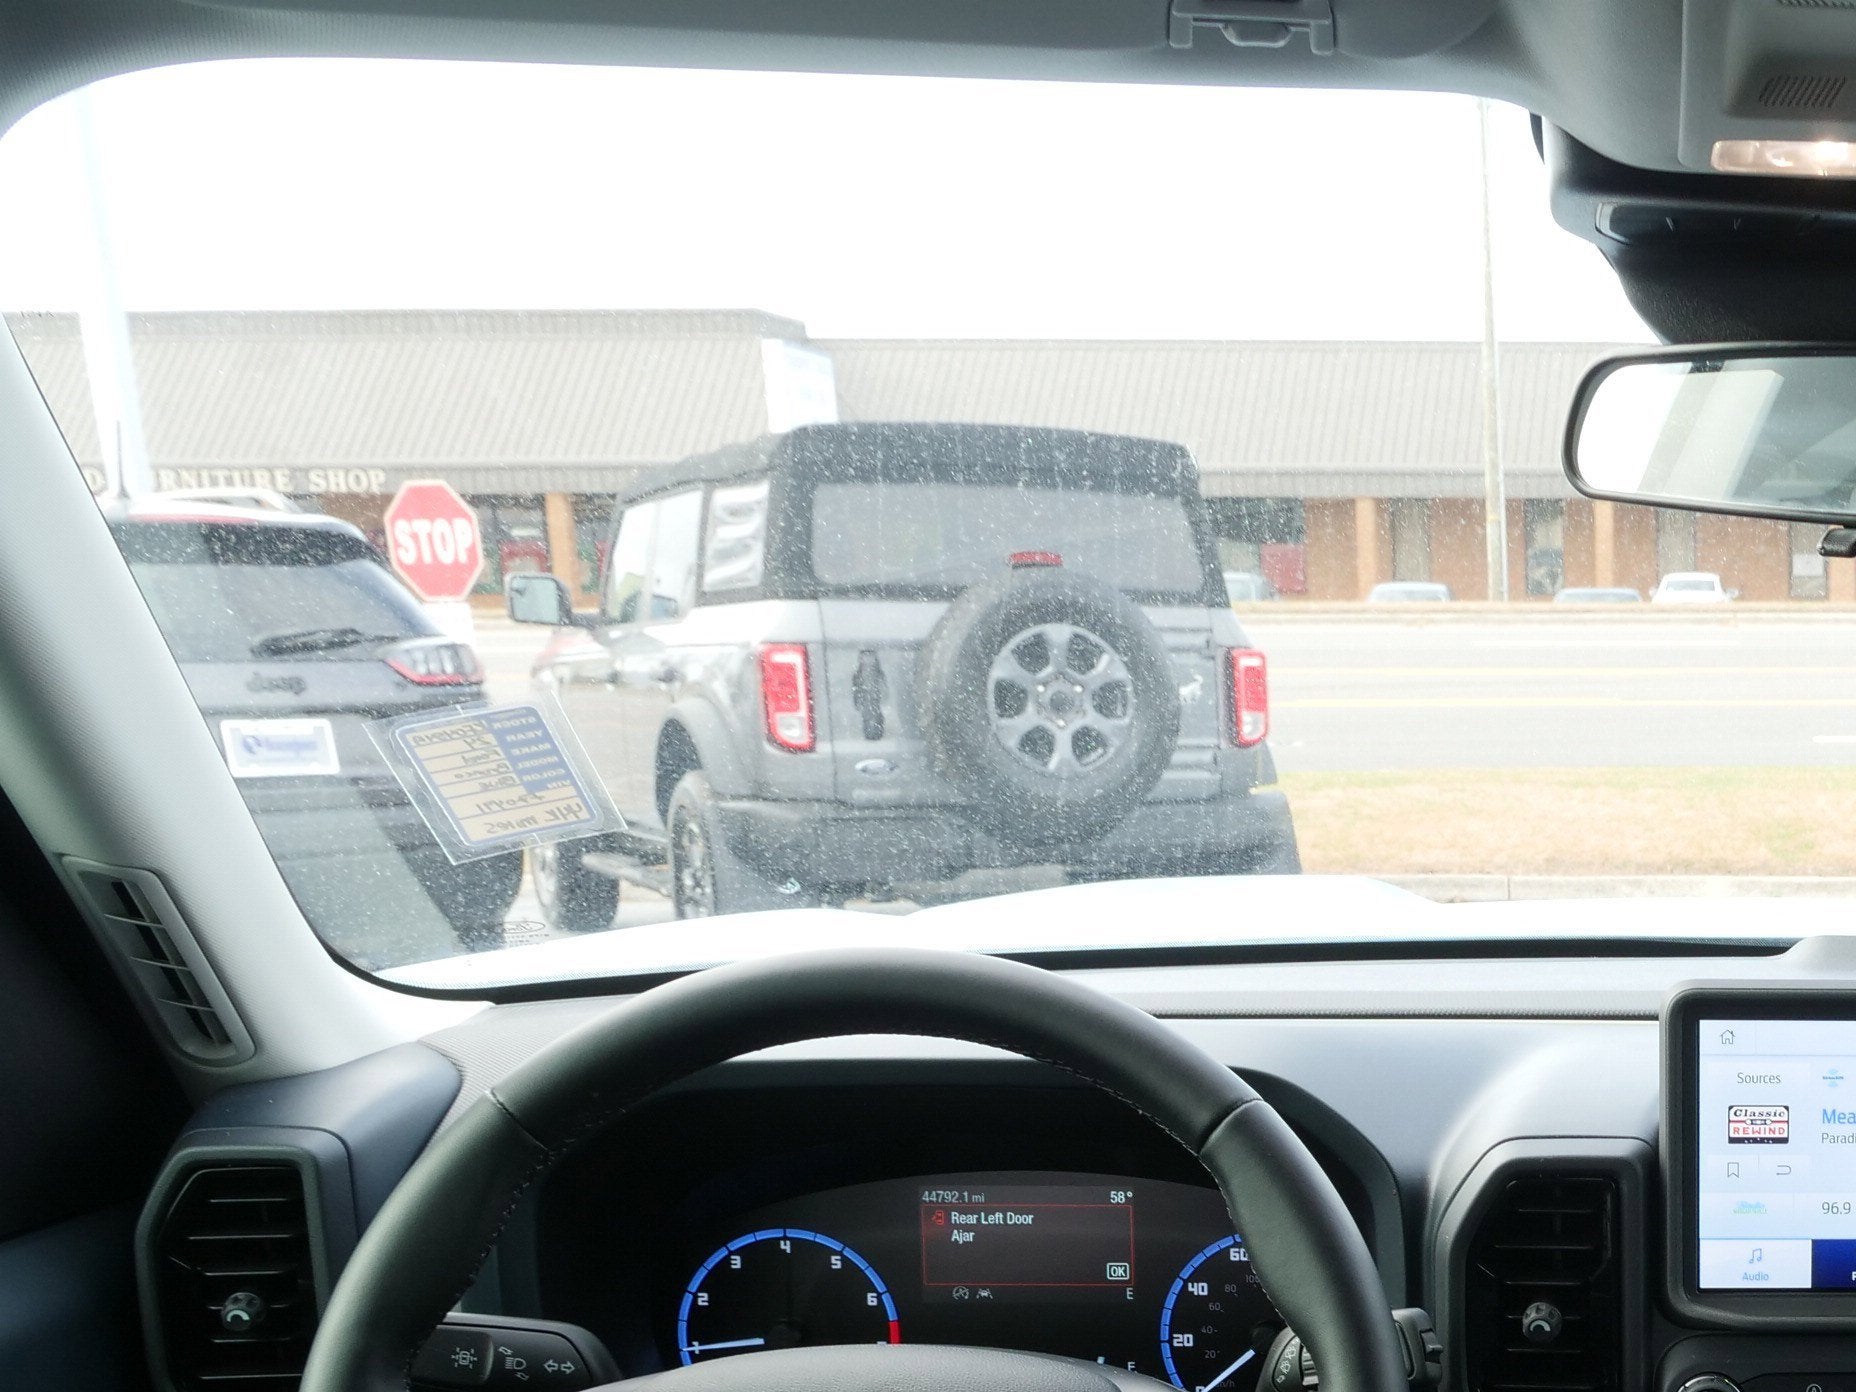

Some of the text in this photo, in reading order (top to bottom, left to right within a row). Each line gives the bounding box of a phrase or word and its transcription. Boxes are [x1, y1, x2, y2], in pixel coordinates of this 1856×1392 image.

[152, 468, 387, 493] RNITURE SHOP
[394, 517, 474, 565] STOP
[1736, 1071, 1782, 1085] Sources
[1733, 1108, 1786, 1118] Classic
[1732, 1125, 1786, 1136] REWIND
[921, 1190, 985, 1203] 44792.1 mi
[1110, 1190, 1133, 1204] 58°
[1821, 1201, 1852, 1215] 96.9
[951, 1211, 1034, 1225] Rear Left Door
[951, 1229, 975, 1245] Ajar
[780, 1240, 791, 1253] 4
[1229, 1248, 1250, 1261] 60
[730, 1255, 741, 1269] 3
[831, 1255, 842, 1269] 5
[1110, 1265, 1126, 1277] OK
[1742, 1271, 1770, 1282] Audio
[1126, 1287, 1134, 1300] E
[1188, 1282, 1208, 1296] 40
[1224, 1284, 1237, 1293] 80
[697, 1293, 708, 1306] 2
[867, 1293, 877, 1306] 6
[1209, 1302, 1220, 1311] 60
[1201, 1325, 1213, 1334] 40
[1172, 1333, 1193, 1347] 20
[1204, 1350, 1216, 1359] 20
